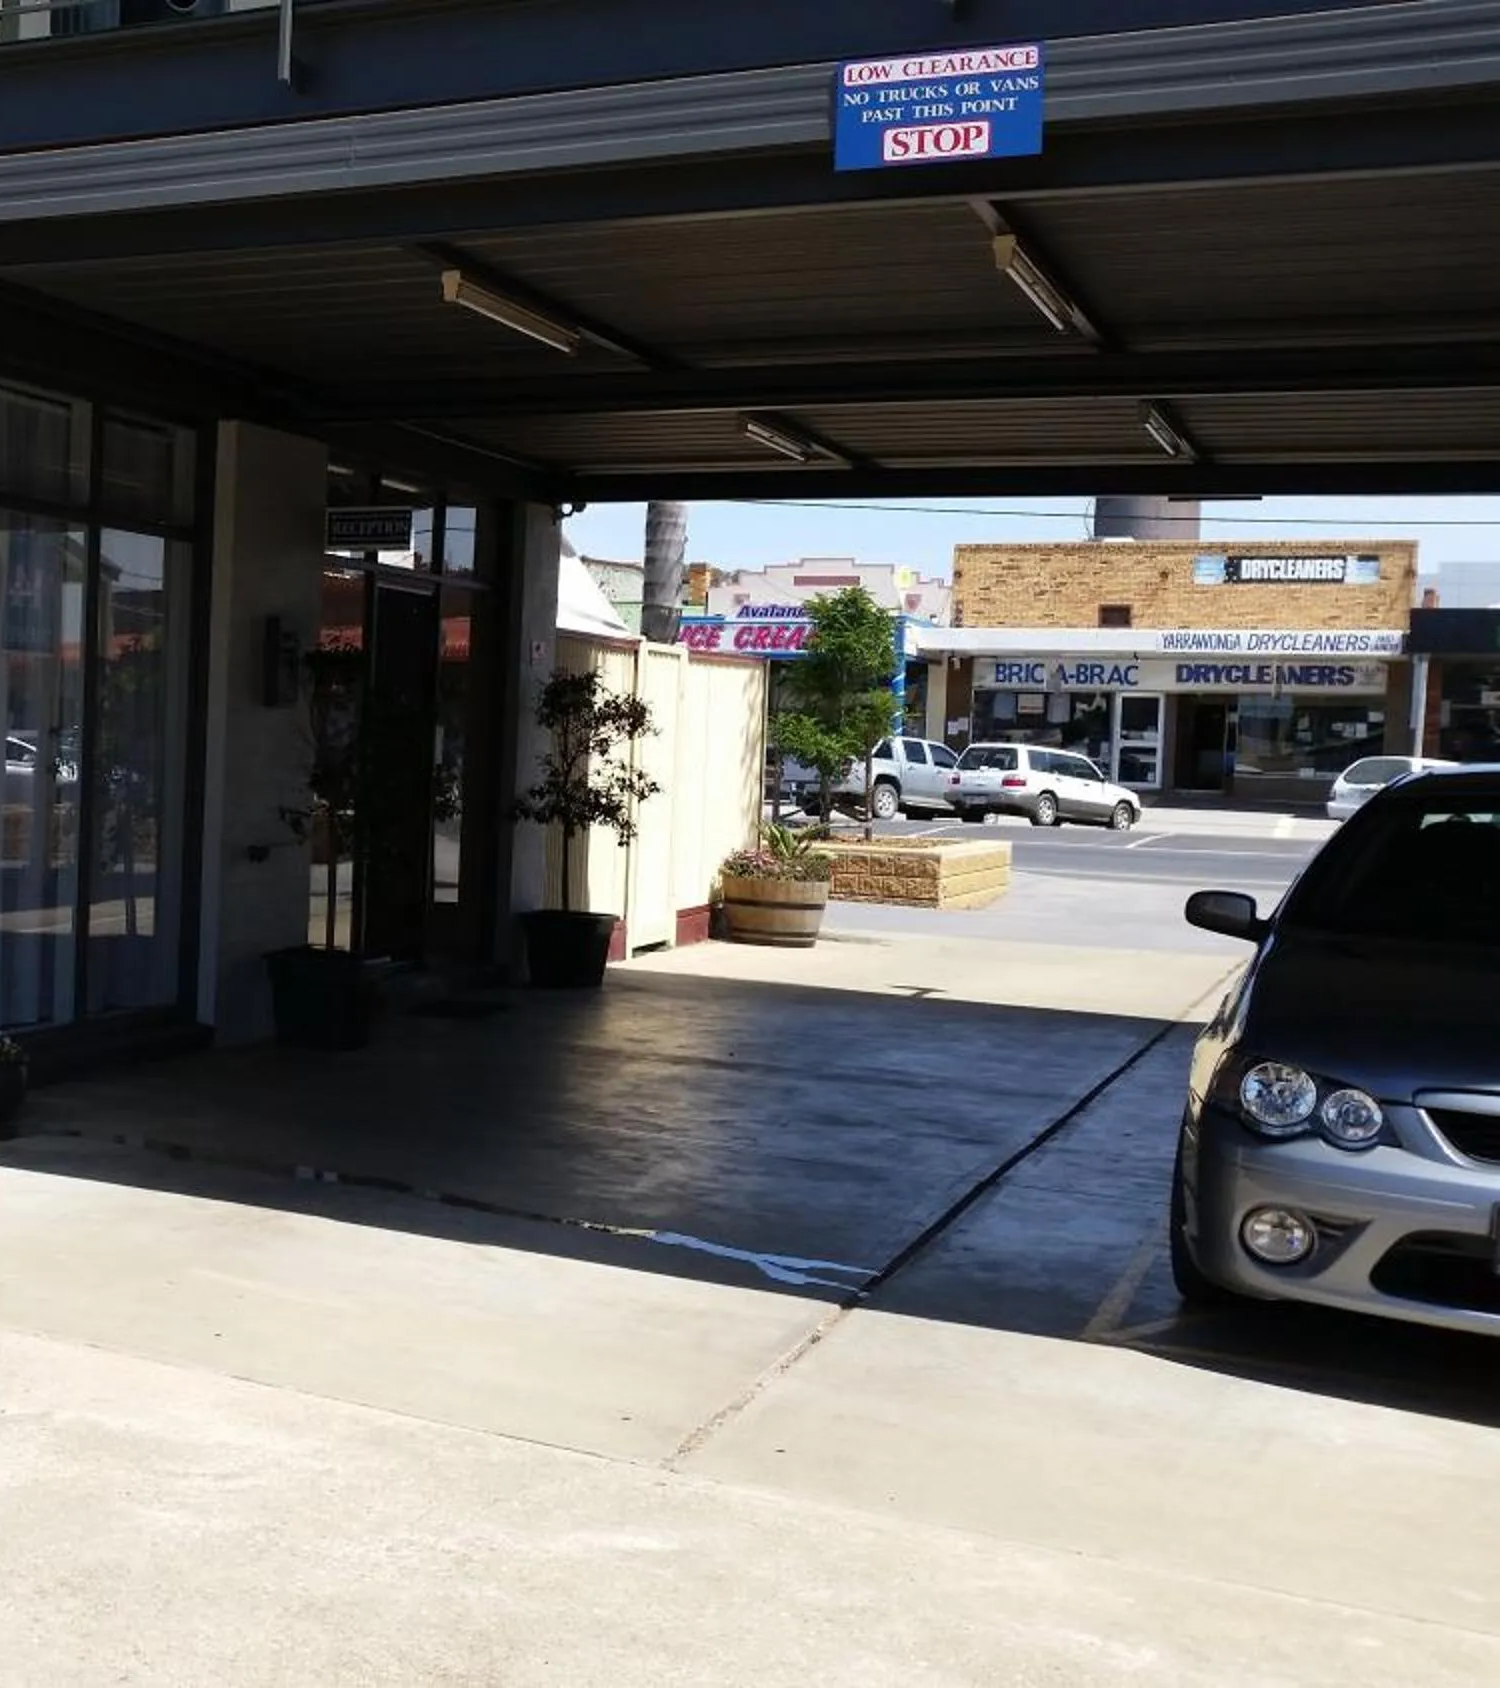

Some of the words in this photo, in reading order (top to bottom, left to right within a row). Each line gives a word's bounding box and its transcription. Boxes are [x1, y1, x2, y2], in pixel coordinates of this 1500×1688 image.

[847, 64, 892, 83] LOW
[902, 49, 1038, 77] CLEARANCE
[843, 92, 869, 107] NO
[878, 84, 949, 103] TRUCKS
[955, 80, 981, 96] OR
[991, 75, 1039, 92] VANS
[862, 107, 904, 123] PAST
[912, 102, 953, 119] THIS
[961, 96, 1018, 115] POINT
[891, 124, 983, 157] STOP
[332, 519, 408, 537] RECEPTION
[1241, 558, 1344, 580] DRYCLEANERS
[733, 625, 808, 649] CREA
[1161, 633, 1241, 650] YARRAWONGA
[1247, 633, 1371, 652] DRYCLEANERS
[995, 663, 1045, 684] BRIC
[1175, 663, 1355, 687] DRYCLEANERS
